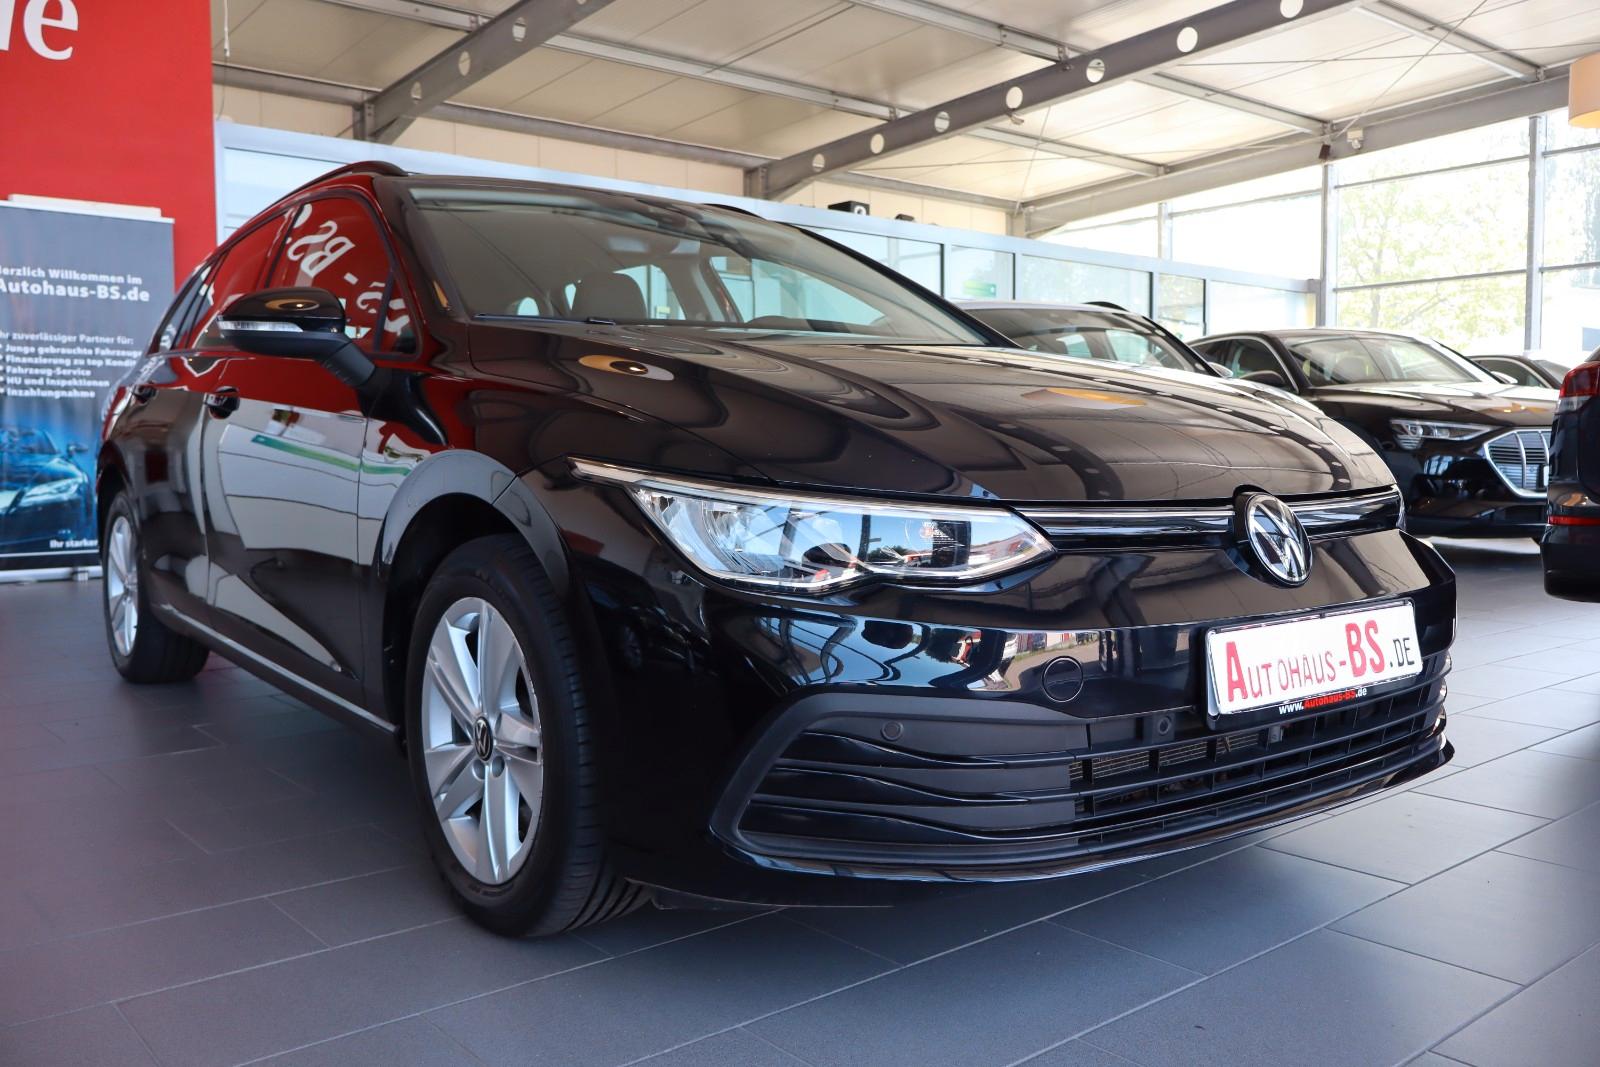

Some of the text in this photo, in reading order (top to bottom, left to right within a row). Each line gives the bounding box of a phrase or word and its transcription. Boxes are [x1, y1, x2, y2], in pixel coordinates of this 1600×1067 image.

[48, 268, 125, 284] Willkommen
[127, 274, 143, 285] im
[79, 333, 115, 345] Partner
[5, 343, 36, 355] Junge
[37, 344, 93, 356] gebrauchte
[5, 354, 72, 367] Finanzierung
[86, 357, 104, 368] top
[5, 364, 92, 377] Fahrzeug-Service
[23, 376, 45, 387] und
[46, 377, 110, 388] Inspektionen
[6, 386, 96, 399] Inzahlungnahme
[1278, 686, 1368, 715] www.Autohaus-BS.de
